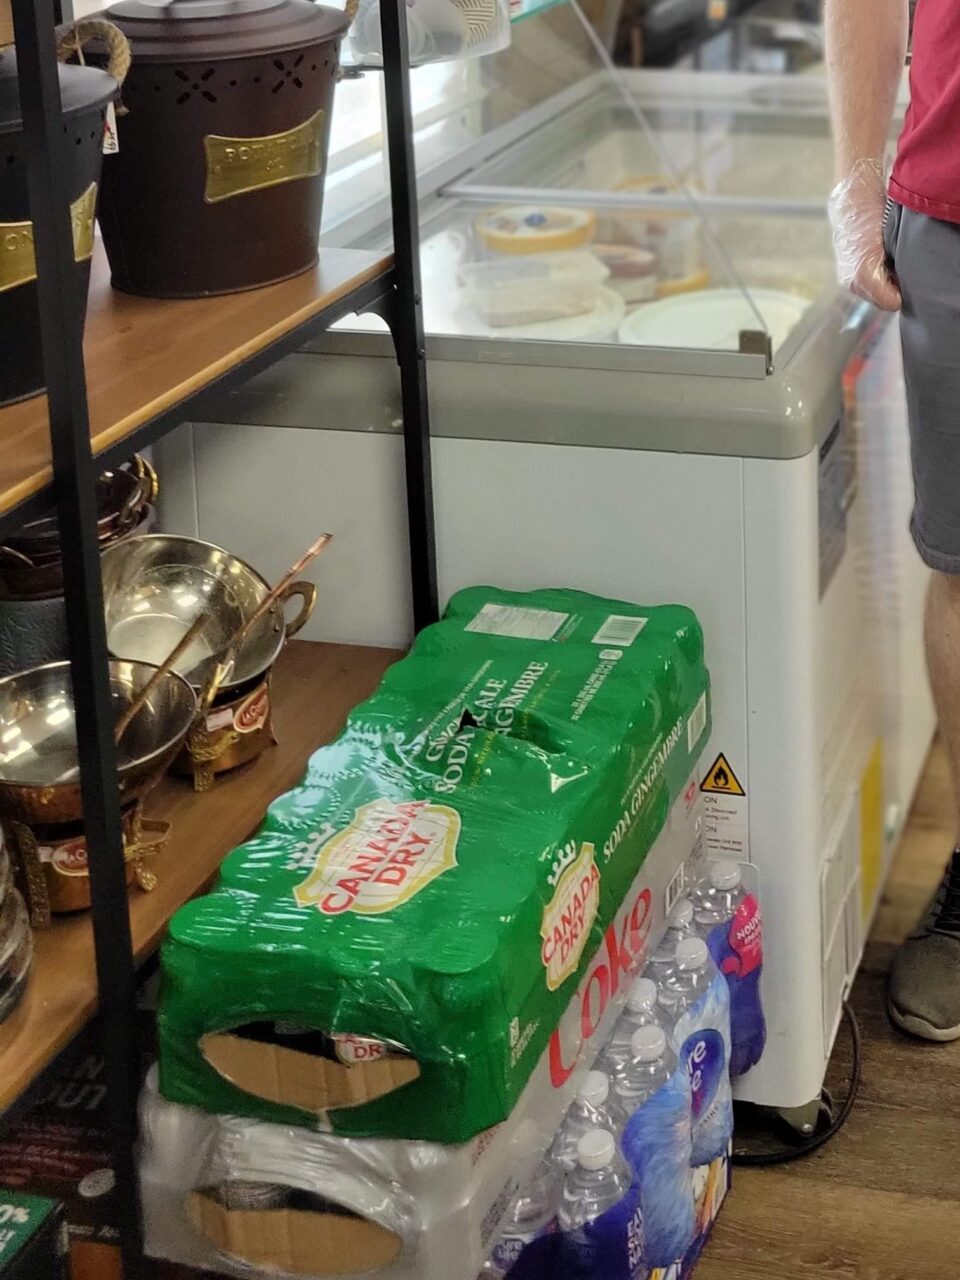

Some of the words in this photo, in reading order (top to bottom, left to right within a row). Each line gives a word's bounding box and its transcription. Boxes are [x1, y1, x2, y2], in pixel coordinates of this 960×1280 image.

[474, 678, 508, 710] ALE
[435, 731, 475, 794] SODA
[603, 810, 631, 864] SODA
[631, 716, 683, 816] GINGEMBRE
[320, 801, 427, 914] CANADA
[372, 831, 433, 887] DRY
[542, 863, 600, 965] CANADA
[559, 910, 588, 966] DRY
[549, 887, 652, 1089] Coke
